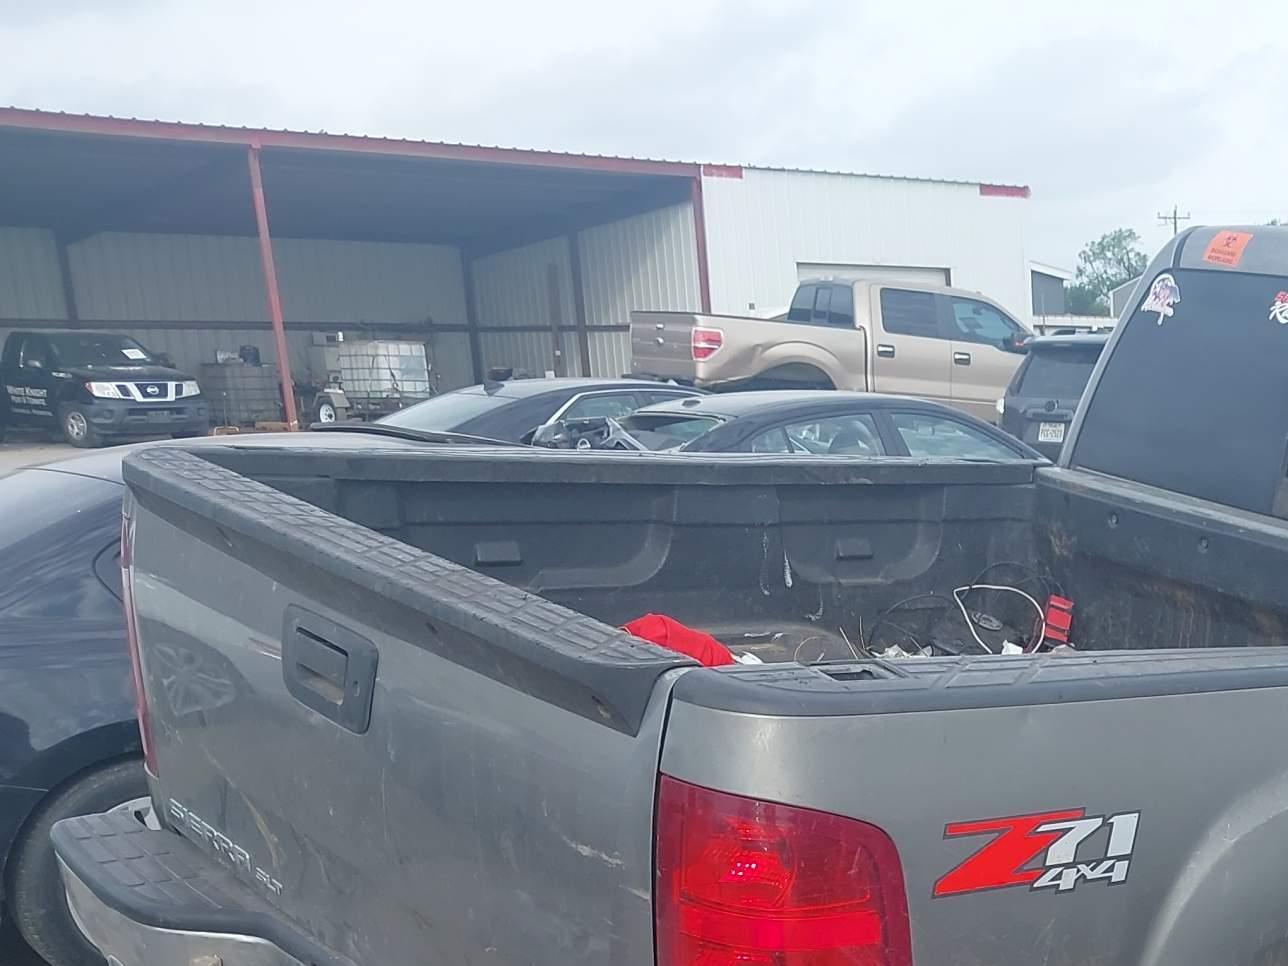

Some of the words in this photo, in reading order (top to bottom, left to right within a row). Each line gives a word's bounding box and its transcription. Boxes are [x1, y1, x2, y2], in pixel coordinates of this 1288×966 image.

[169, 797, 251, 873] SIERRA
[255, 866, 283, 896] SLT
[932, 807, 1141, 899] Z71
